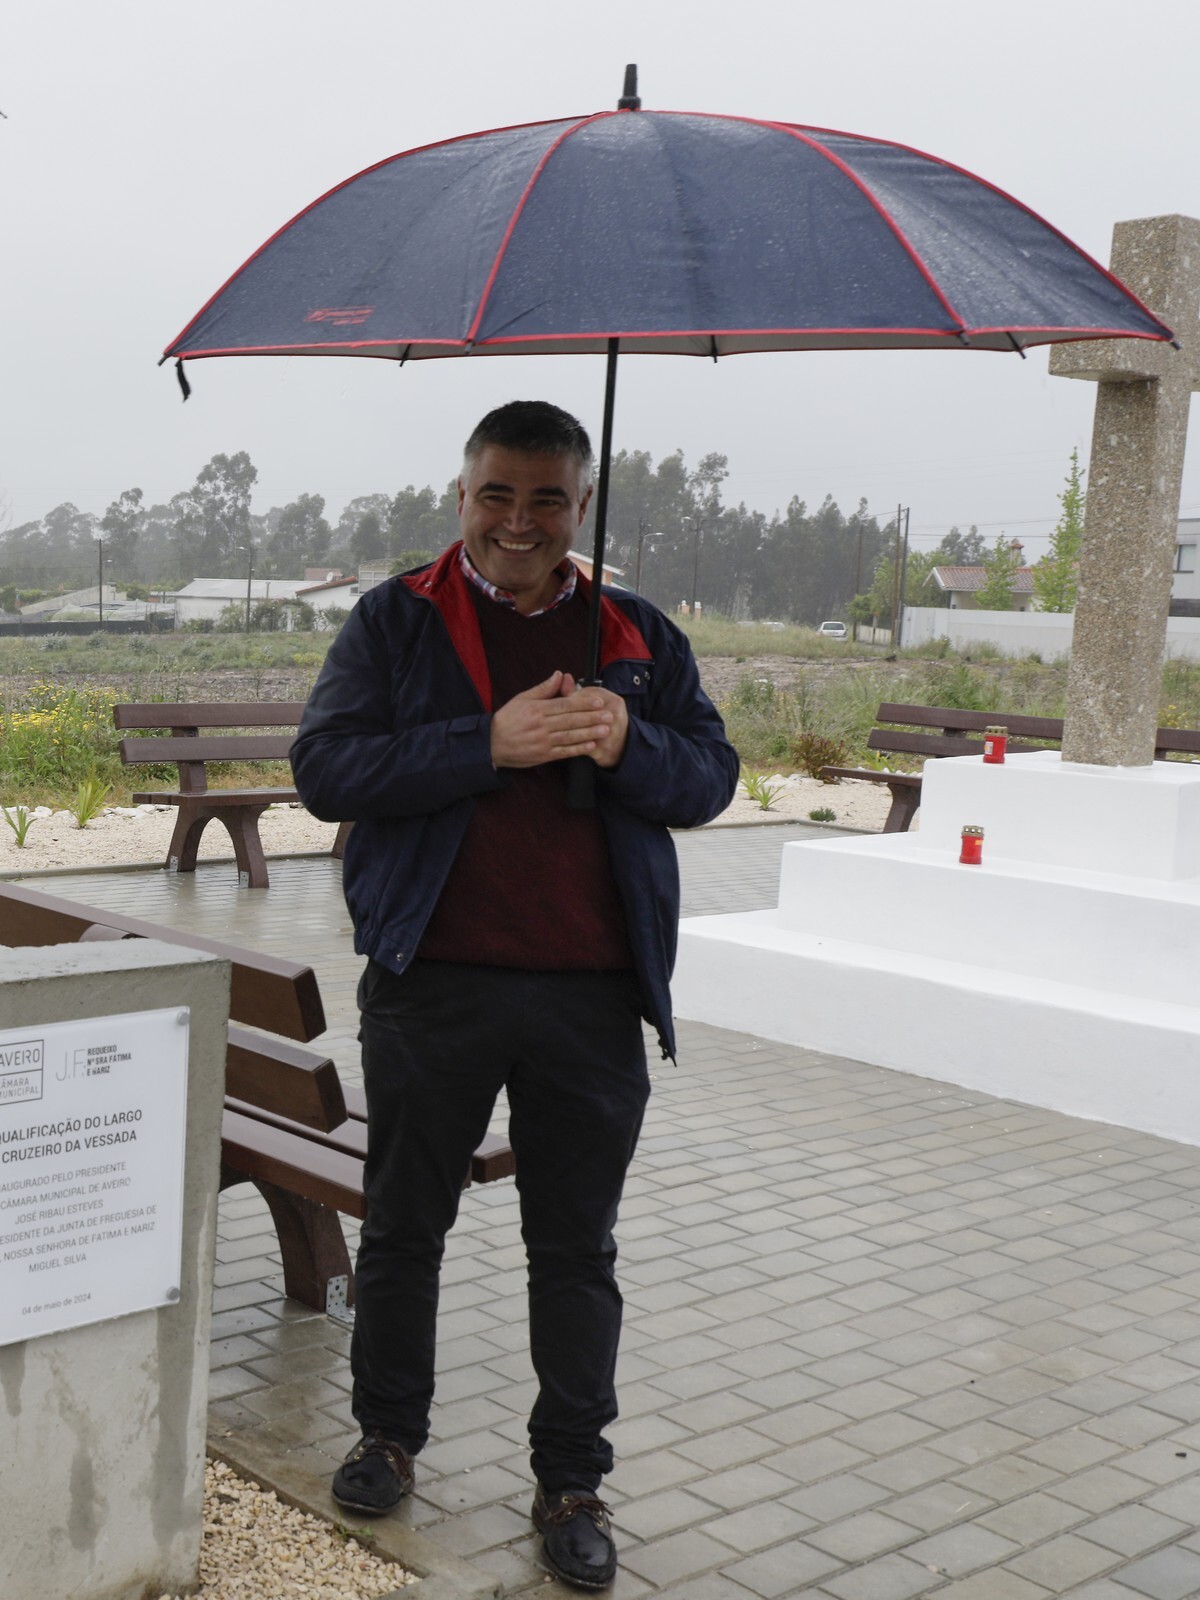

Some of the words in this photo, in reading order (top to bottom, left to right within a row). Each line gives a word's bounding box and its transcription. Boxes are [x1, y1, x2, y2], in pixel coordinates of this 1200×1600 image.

[84, 1116, 100, 1130] DO
[104, 1109, 142, 1126] LARGO
[2, 1142, 62, 1164] CRUZEIRO
[66, 1140, 81, 1152] DA
[84, 1130, 137, 1148] VESSADA
[52, 1170, 74, 1183] PELO
[75, 1161, 126, 1179] PRESIDENTE
[40, 1186, 86, 1202] MUNICIPAL
[88, 1183, 100, 1194] DE
[102, 1177, 131, 1191] AVEIRO
[38, 1206, 66, 1220] RIBAU
[67, 1199, 104, 1215] ESTEVES
[42, 1226, 55, 1237] DA
[57, 1220, 86, 1234] JUNTA
[86, 1218, 98, 1228] DE
[100, 1208, 144, 1225] FREGUESIA
[146, 1205, 157, 1216] DE
[4, 1248, 34, 1261] NOSSA
[36, 1238, 77, 1256] SENHORA
[78, 1235, 90, 1246] DE
[124, 1226, 129, 1237] E
[130, 1221, 156, 1235] NARIZ
[28, 1258, 62, 1273] MIGUEL
[64, 1253, 87, 1266] SILVA
[22, 1306, 32, 1316] 04
[33, 1305, 42, 1314] de
[44, 1300, 62, 1311] maio
[63, 1298, 72, 1307] de
